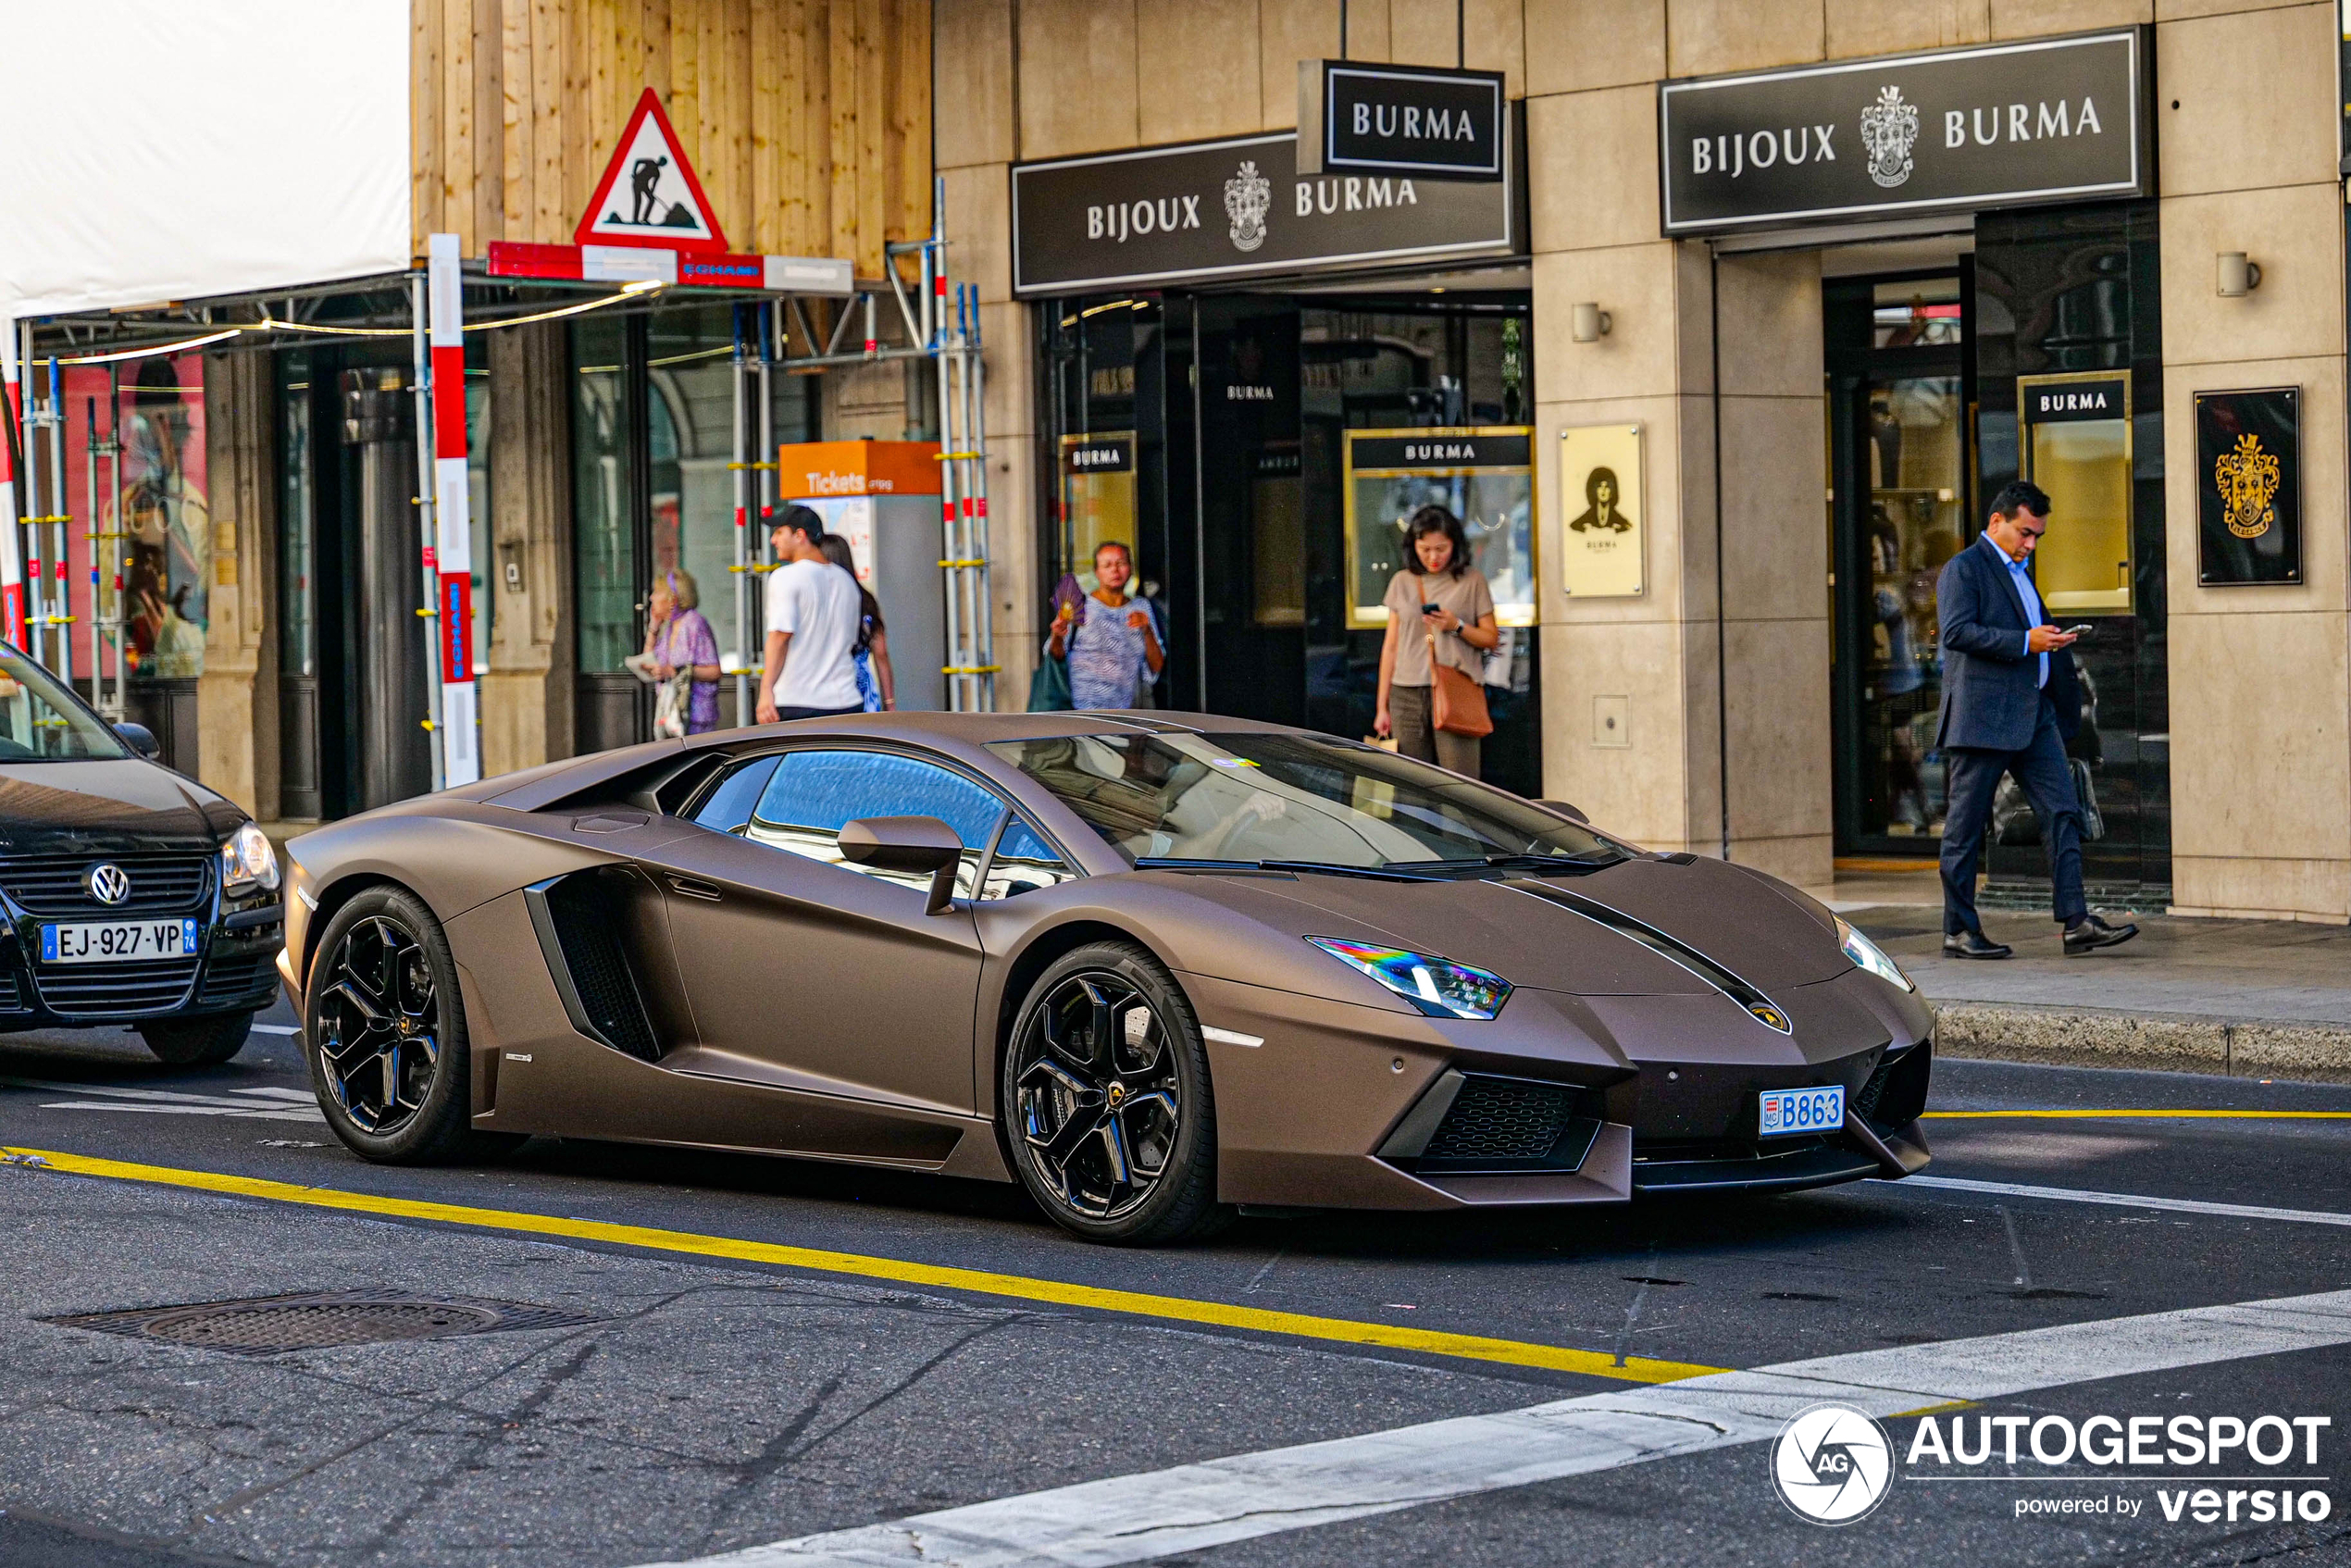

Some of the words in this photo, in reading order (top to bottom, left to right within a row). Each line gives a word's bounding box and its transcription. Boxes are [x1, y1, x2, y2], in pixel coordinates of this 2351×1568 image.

[1352, 103, 1475, 143] BURMA
[1692, 123, 1836, 179] BIJOUX
[1945, 96, 2102, 149] BURMA
[1087, 194, 1200, 243] BIJOUX
[1295, 178, 1417, 218] BURMA
[1226, 385, 1274, 400] BURMA
[2039, 392, 2108, 412] BURMA
[1073, 449, 1120, 466] BURMA
[1405, 443, 1475, 460] BURMA
[806, 471, 865, 493] Tickets
[47, 945, 53, 954] F
[60, 925, 180, 957] EJ-927-VP
[184, 935, 195, 951] 74
[1765, 1113, 1777, 1123] MC
[1783, 1092, 1840, 1127] B863
